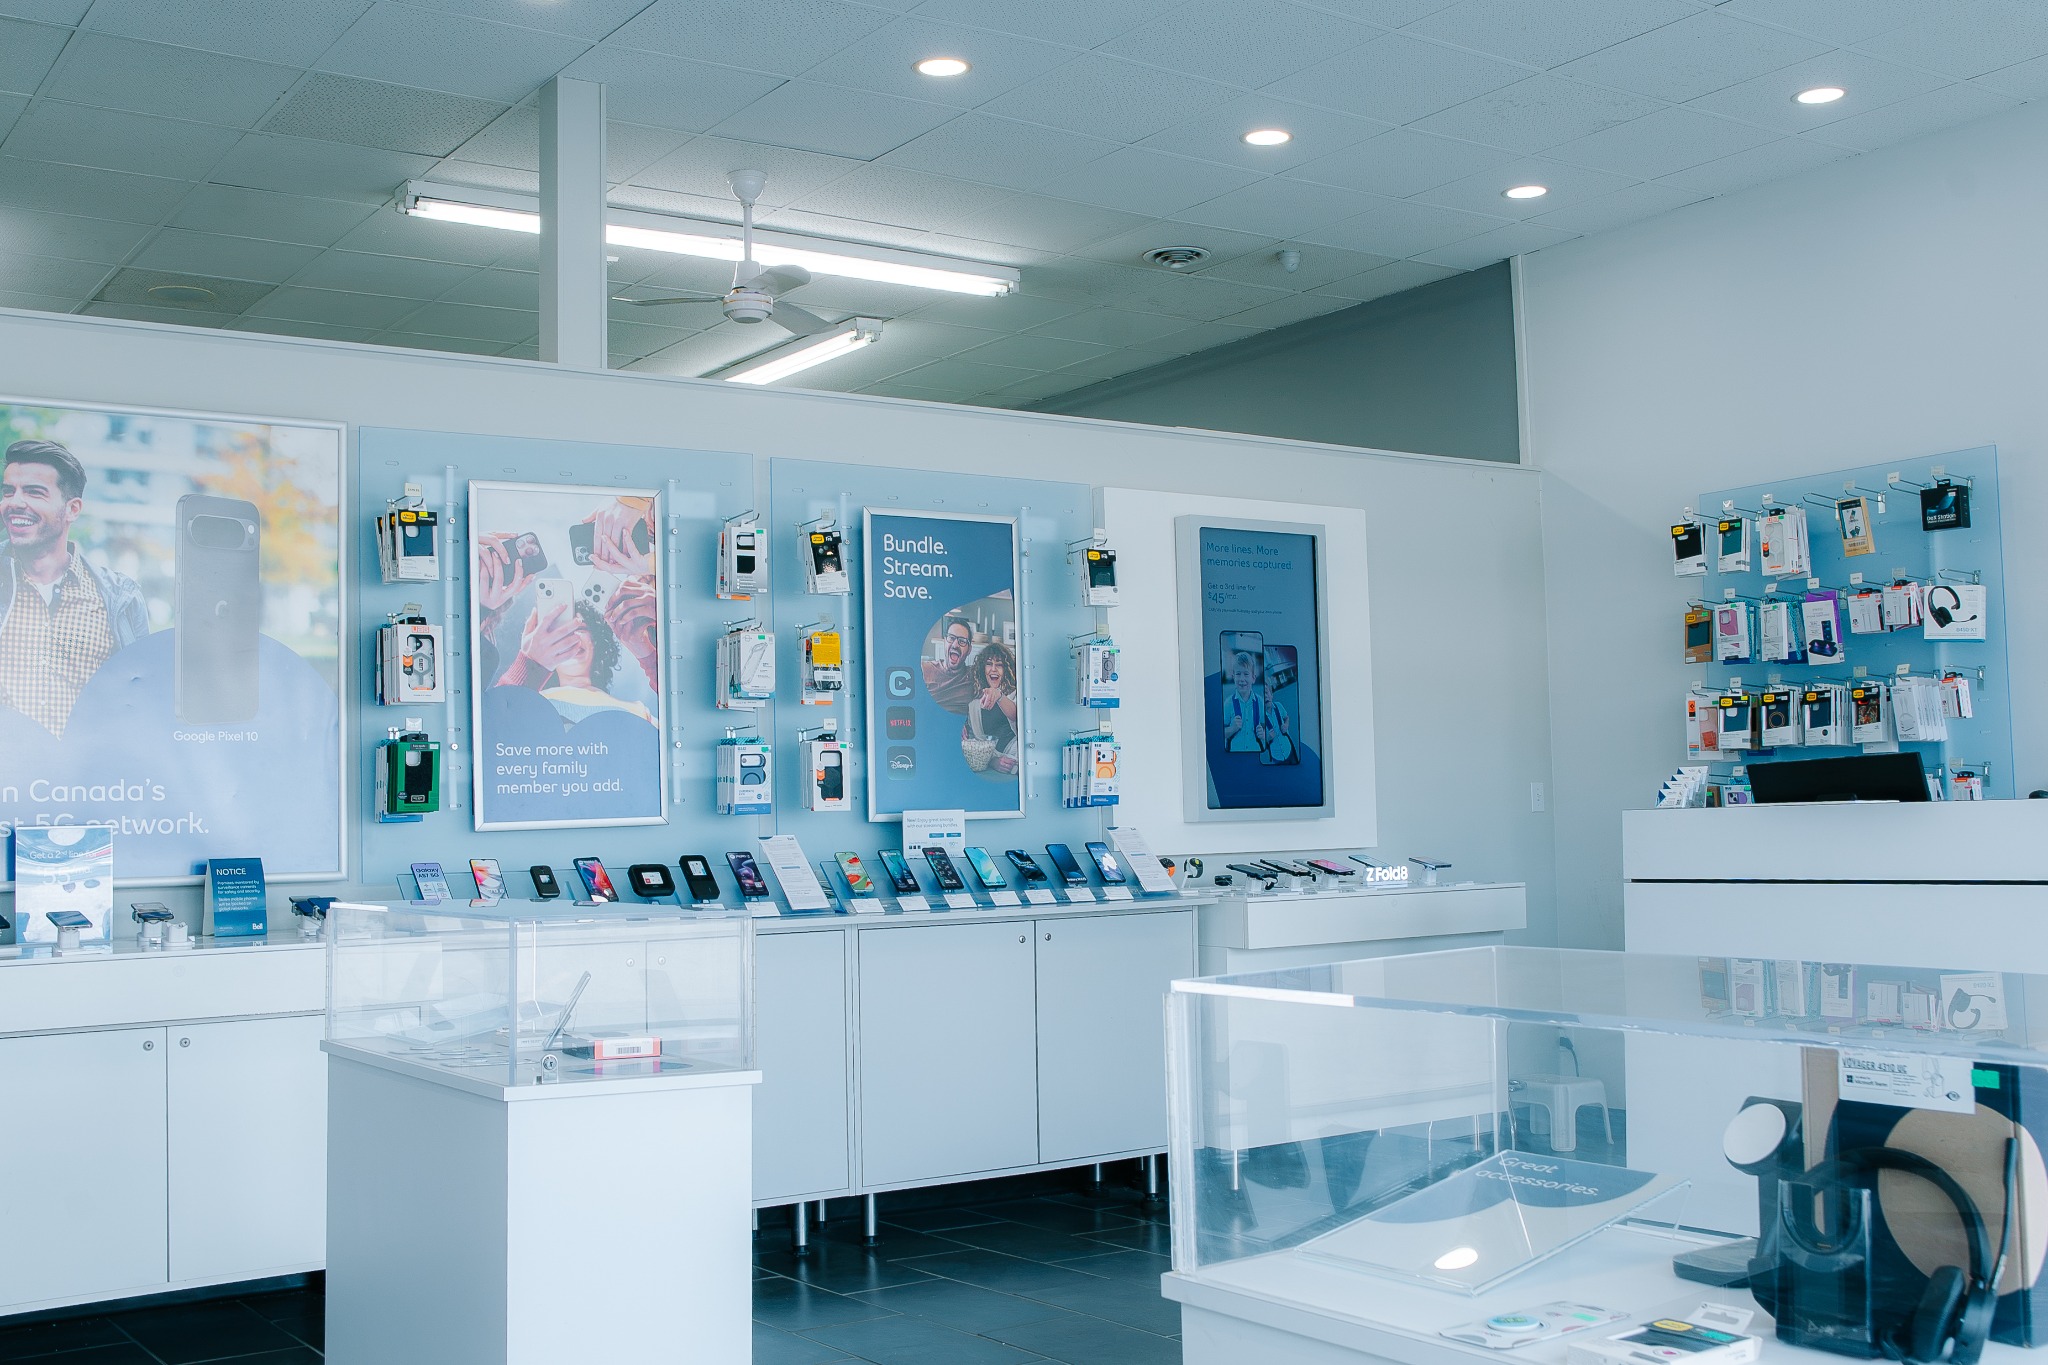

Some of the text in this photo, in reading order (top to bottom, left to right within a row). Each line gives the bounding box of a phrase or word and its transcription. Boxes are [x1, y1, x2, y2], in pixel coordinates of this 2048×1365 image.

[883, 533, 948, 555] Bundle.
[1206, 541, 1280, 556] More lines. More
[883, 556, 953, 578] Stream.
[1206, 558, 1294, 571] memories captured.
[883, 579, 932, 600] Save.
[1207, 582, 1219, 590] Get
[889, 719, 912, 727] NETFLIX
[173, 730, 259, 744] Google Pixel 10
[496, 741, 609, 757] Save more with
[496, 761, 588, 779] every family
[497, 778, 624, 797] member you add.
[216, 867, 247, 876] NOTICE
[1366, 866, 1408, 881] Z Fold8
[252, 922, 263, 930] Bell
[1498, 1157, 1559, 1174] Great
[1475, 1169, 1600, 1196] accessories.
